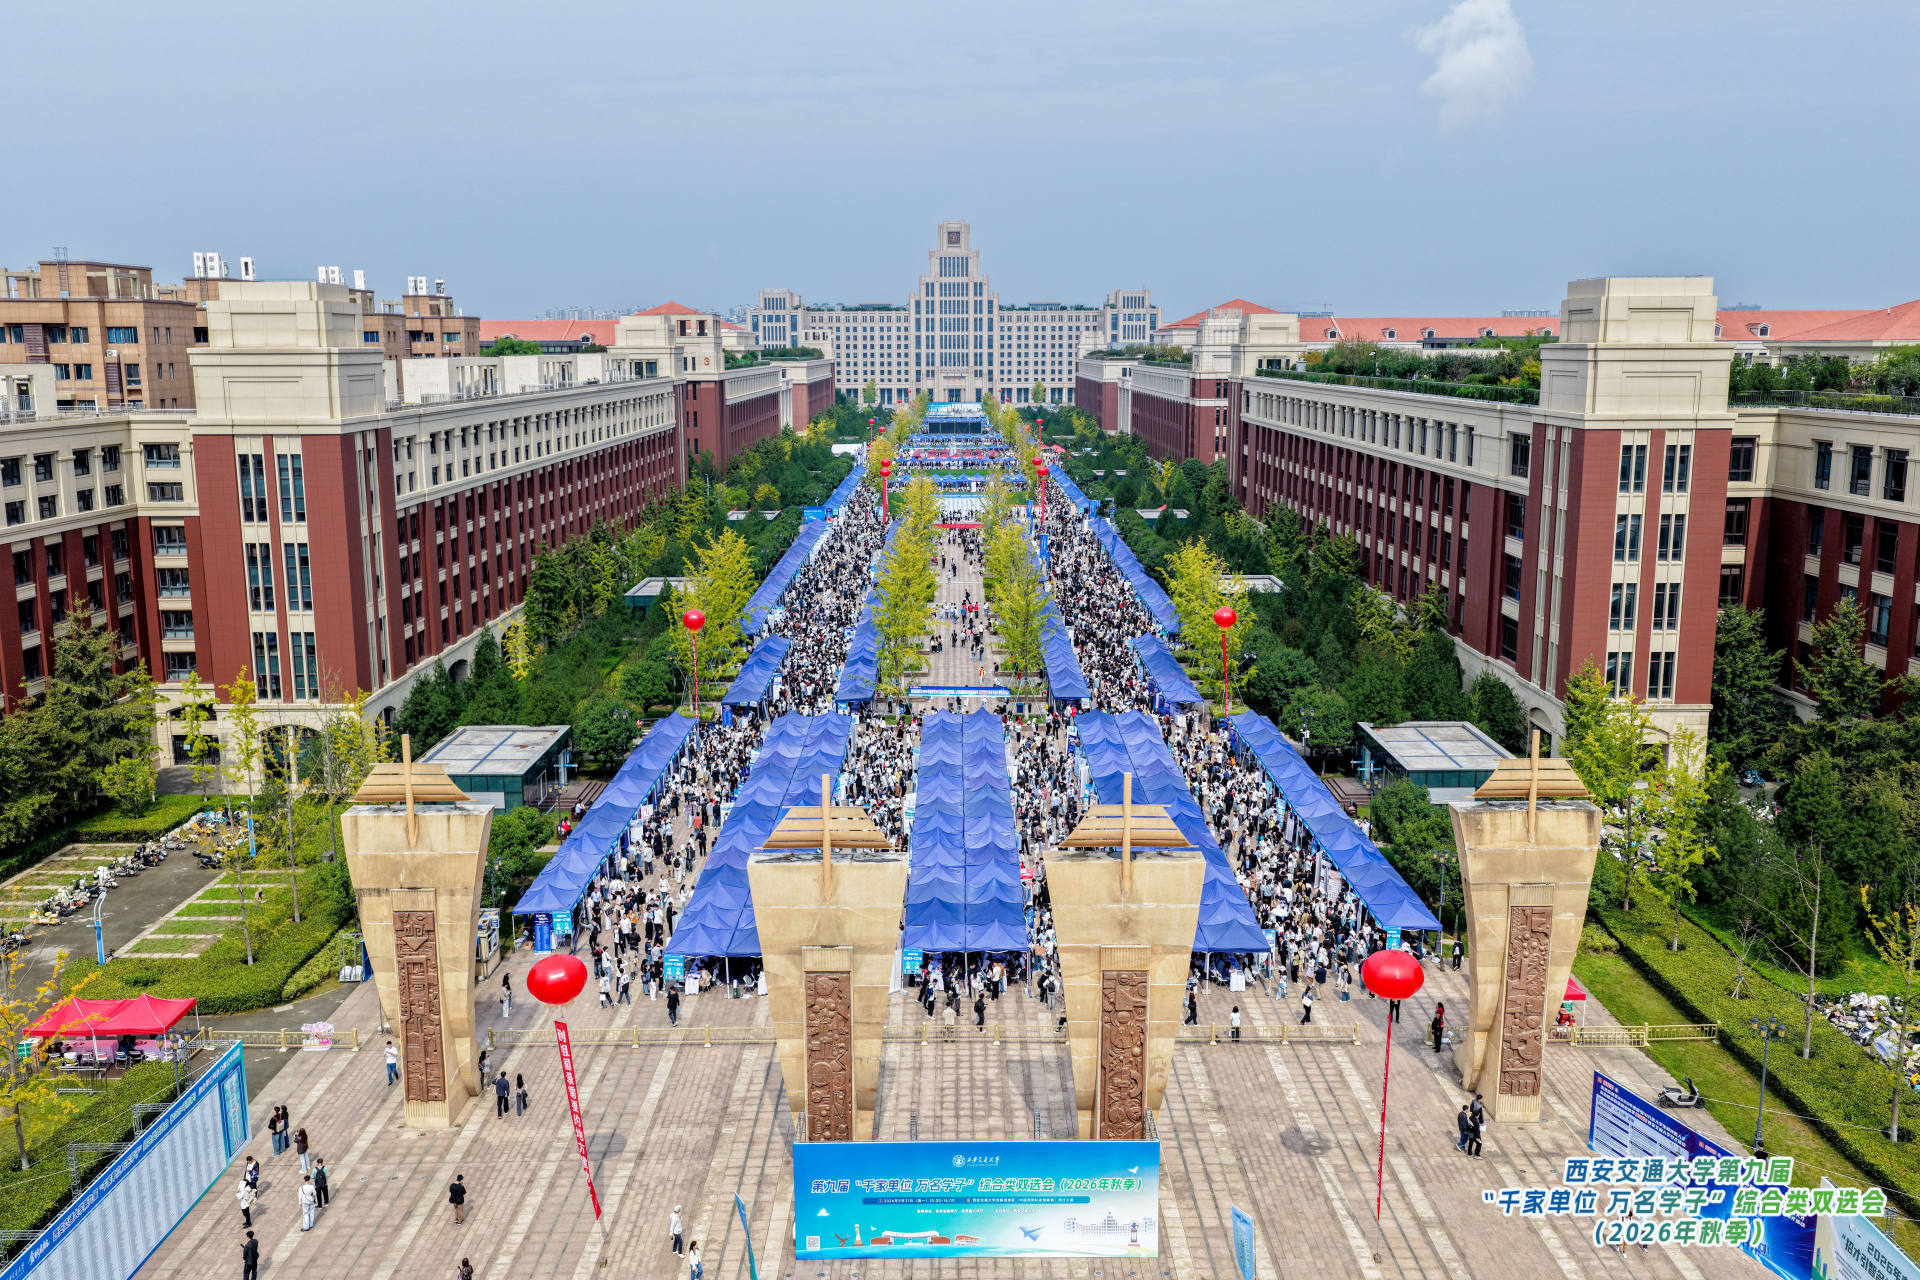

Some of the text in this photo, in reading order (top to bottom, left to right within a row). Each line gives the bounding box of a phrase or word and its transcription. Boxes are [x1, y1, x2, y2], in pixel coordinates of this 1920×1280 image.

[704, 356, 710, 366] 3
[811, 1179, 850, 1193] 第九届
[1842, 1233, 1889, 1280] “招才引智名
[1867, 1242, 1908, 1280] 2026年
